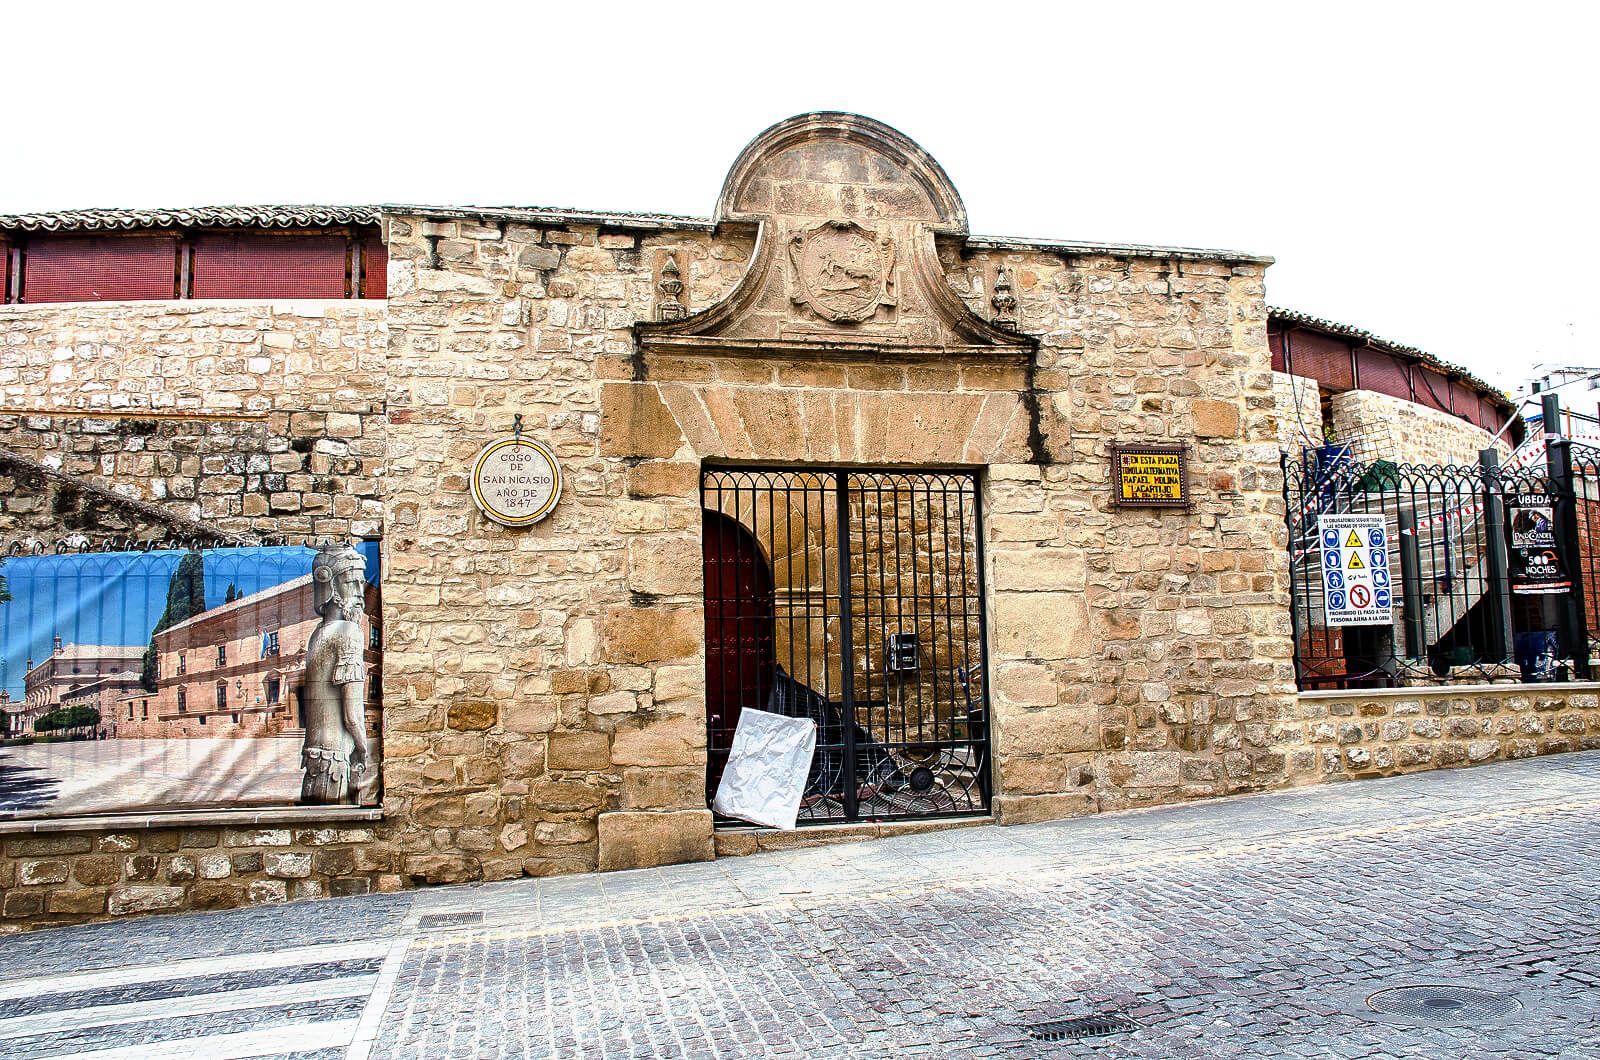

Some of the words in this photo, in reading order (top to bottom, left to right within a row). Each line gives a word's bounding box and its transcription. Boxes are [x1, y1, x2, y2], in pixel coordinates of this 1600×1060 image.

[500, 454, 532, 462] COSO
[1130, 456, 1138, 464] EN
[483, 476, 506, 484] SAN
[508, 475, 550, 484] NICASIO
[496, 488, 518, 497] AÑO
[504, 499, 530, 508] 1847
[1526, 566, 1556, 574] NOCHES
